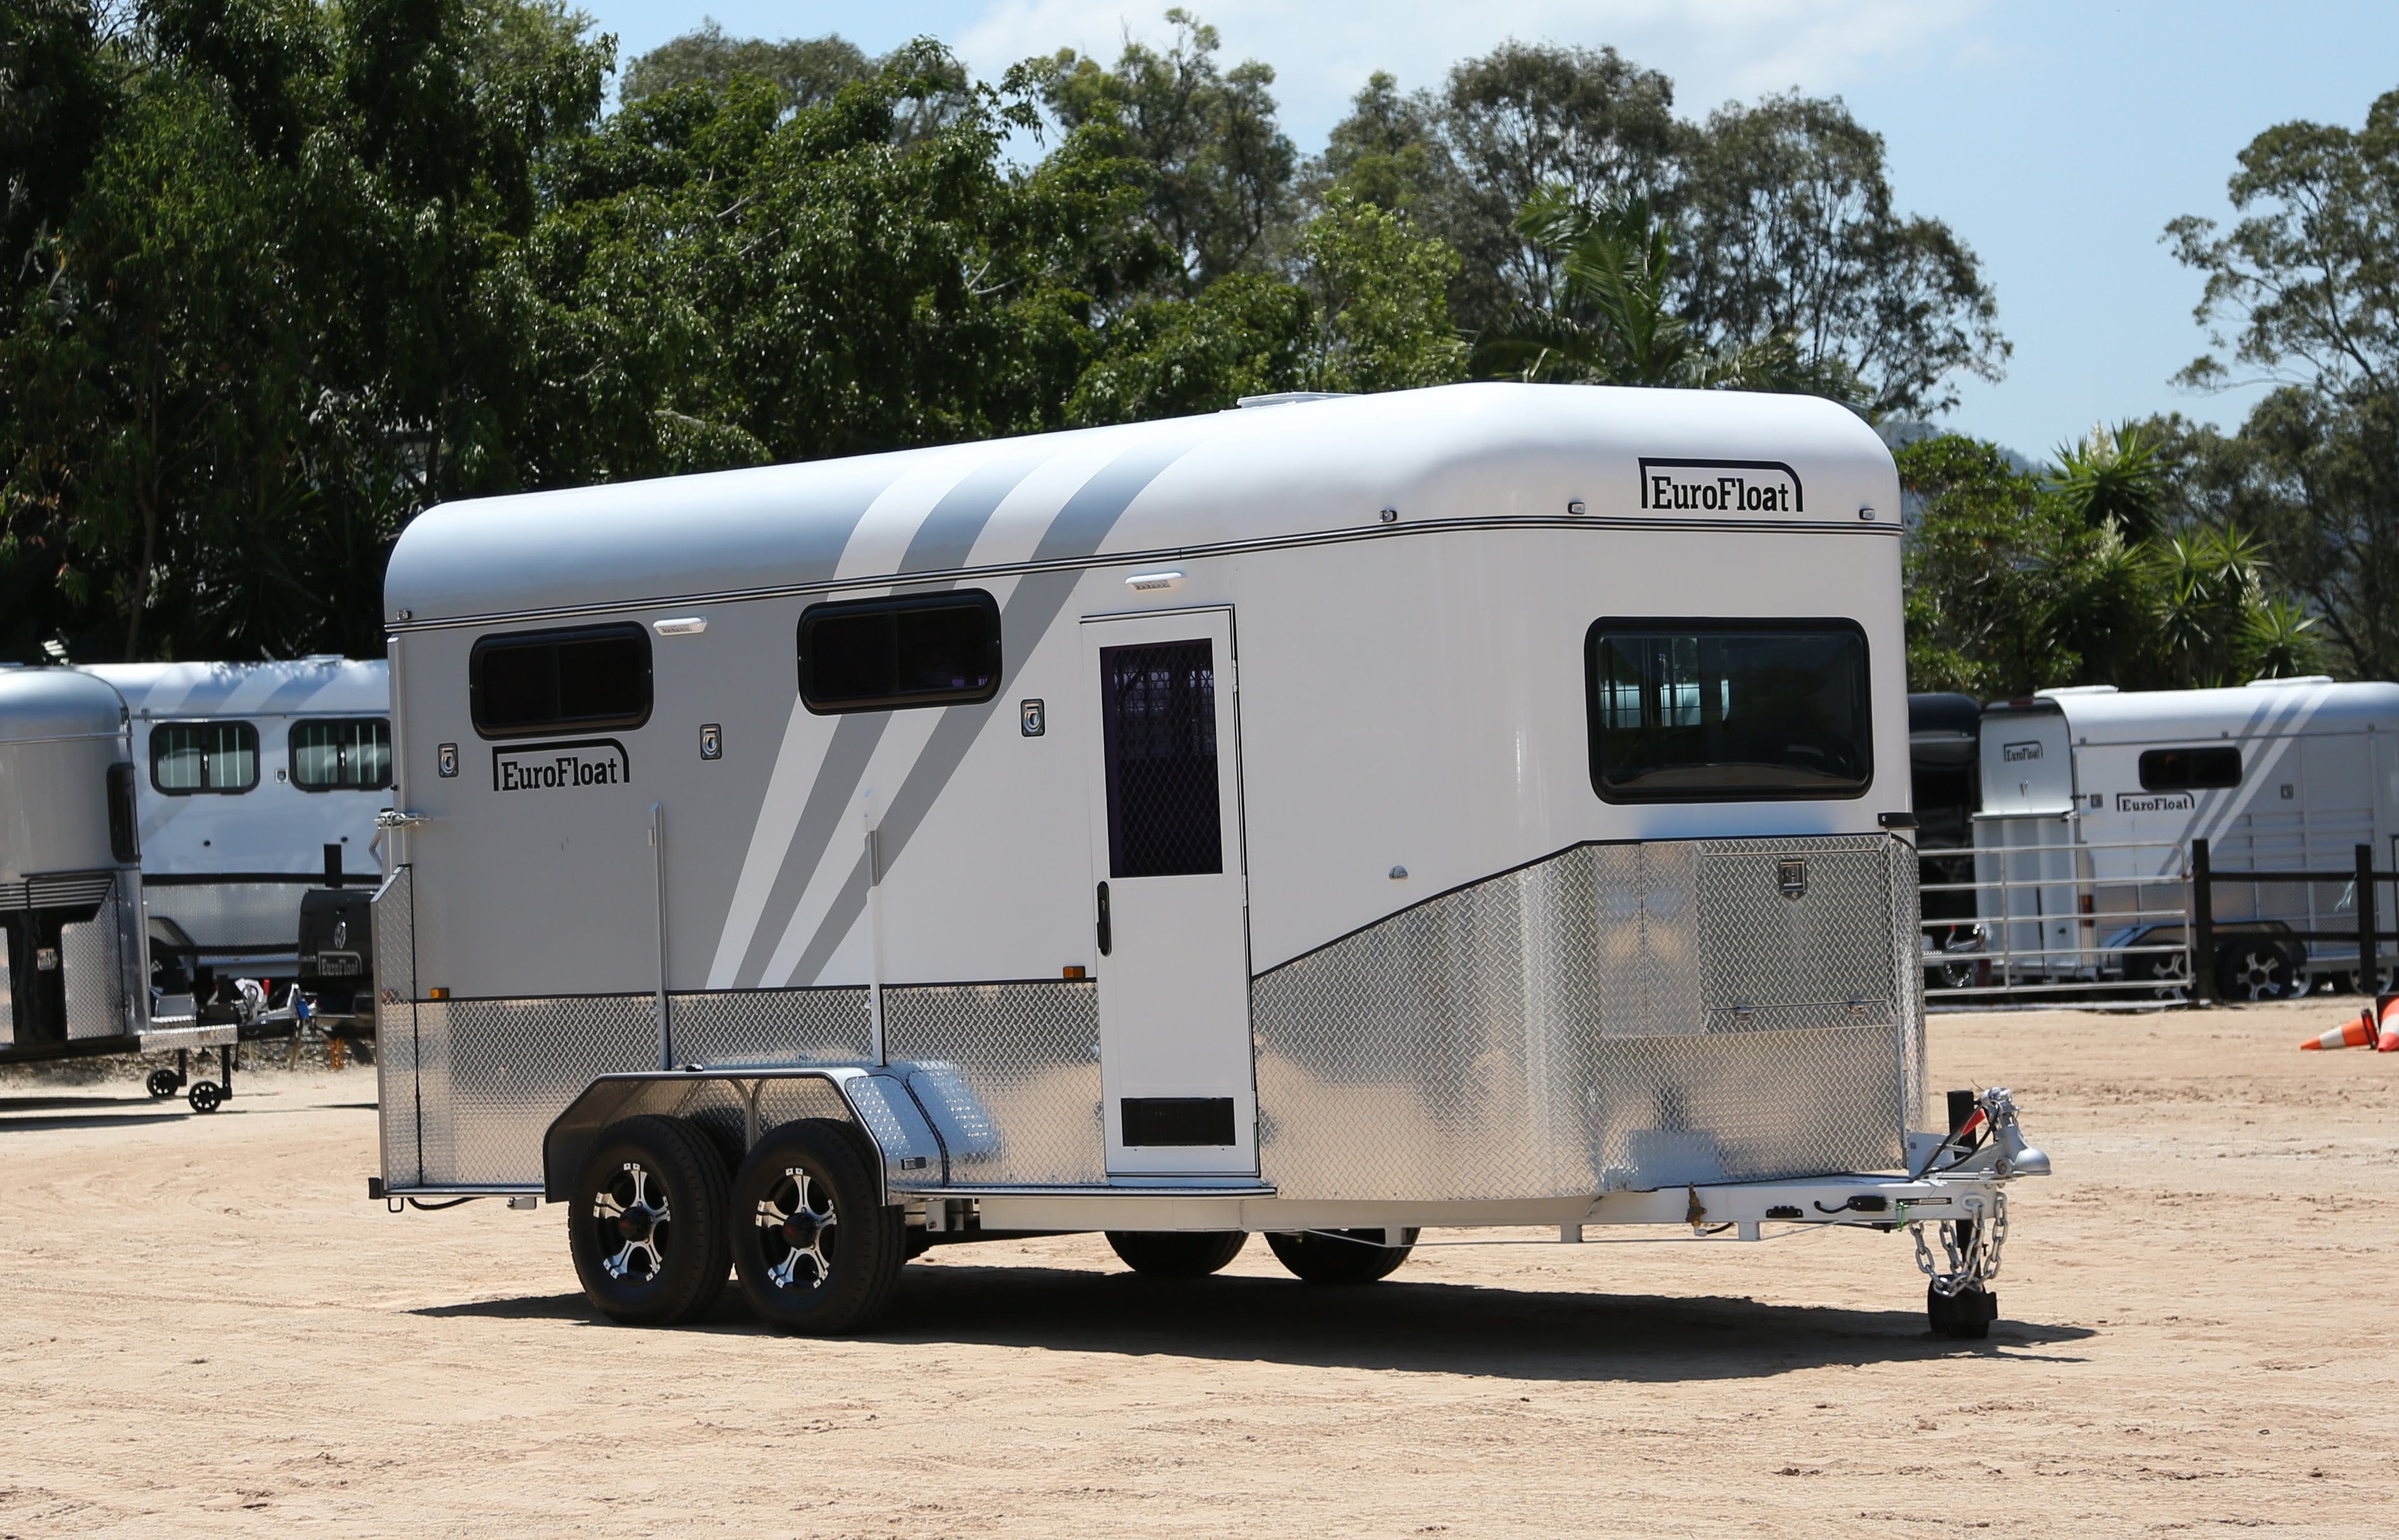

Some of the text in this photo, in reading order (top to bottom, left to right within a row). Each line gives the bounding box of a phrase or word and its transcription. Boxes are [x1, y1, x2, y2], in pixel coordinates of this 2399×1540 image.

[1651, 476, 1789, 512] EuroFloat
[2007, 748, 2040, 762] EuroFloat
[501, 757, 618, 791] EuroFloat
[2123, 797, 2188, 811] EuroFloat
[322, 958, 358, 975] EuroFloat
